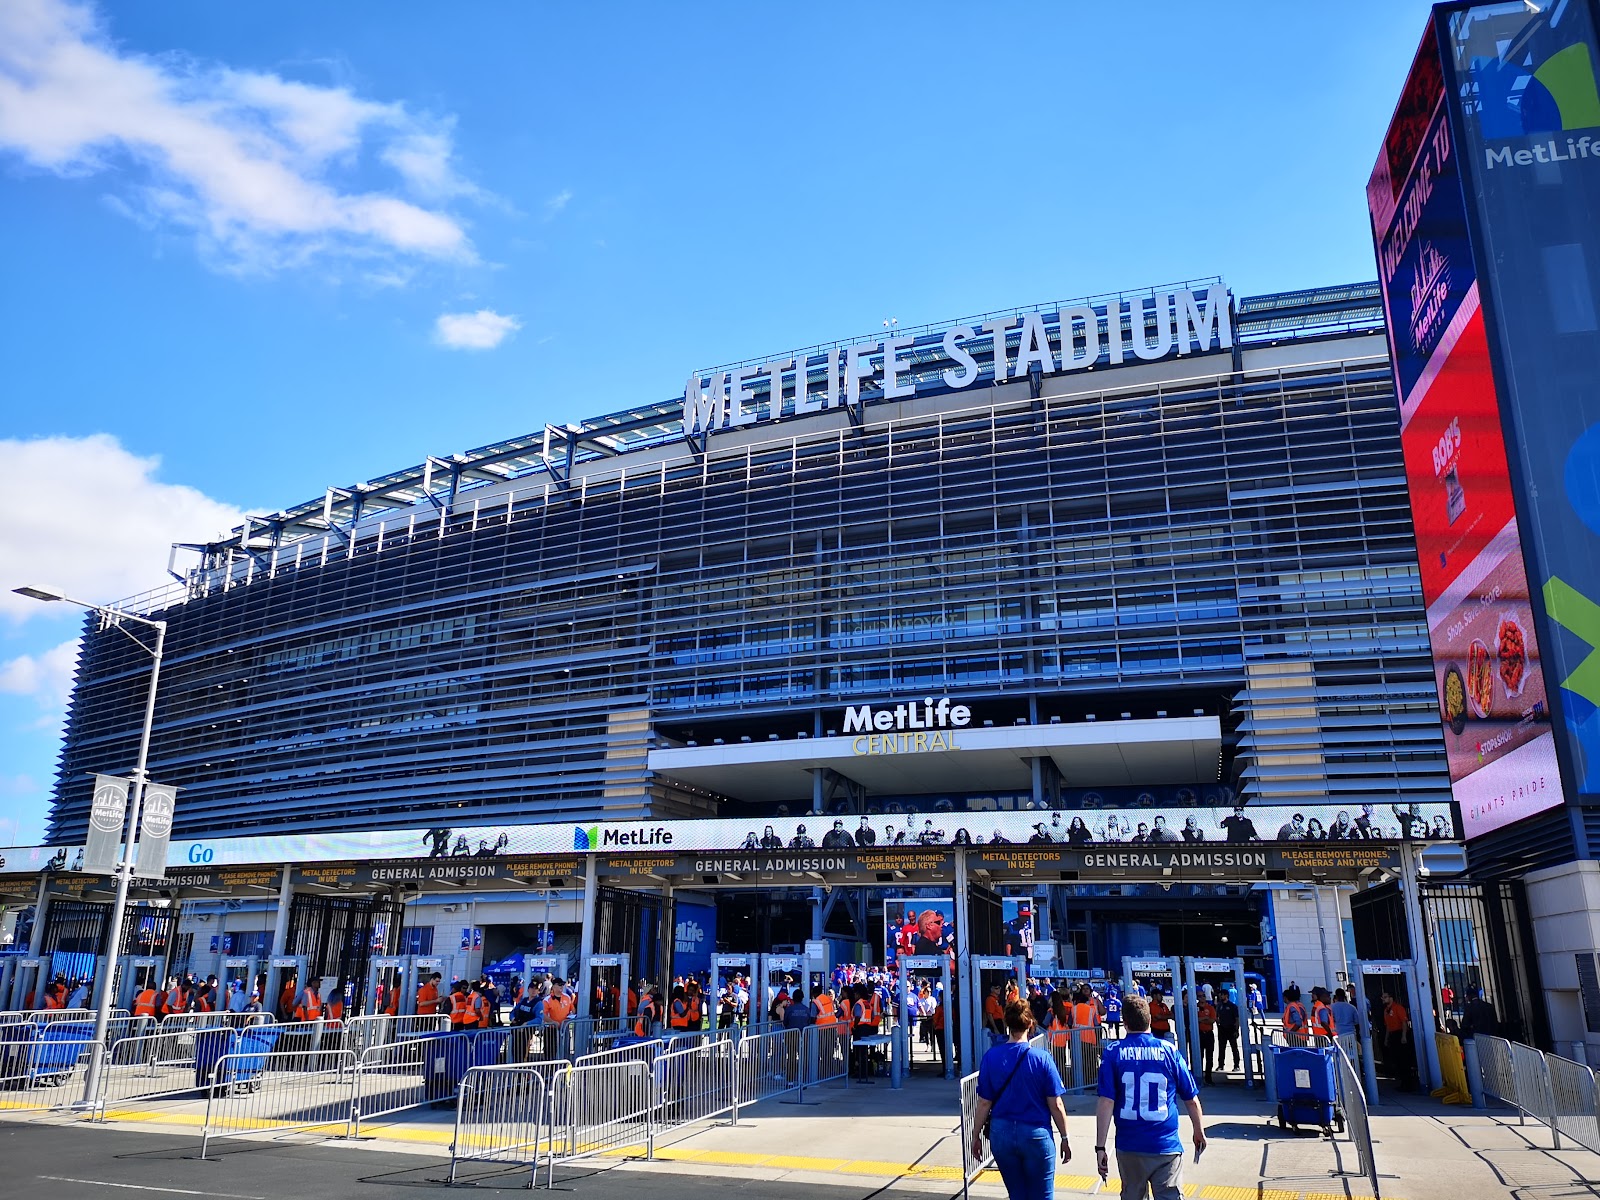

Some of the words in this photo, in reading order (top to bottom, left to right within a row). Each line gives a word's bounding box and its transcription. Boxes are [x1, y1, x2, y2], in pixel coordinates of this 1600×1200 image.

[1385, 152, 1433, 283] WELCOME
[1433, 115, 1449, 174] TO
[1415, 280, 1448, 348] MetLife
[683, 335, 916, 435] METLIFE
[942, 283, 1233, 388] STADIUM
[1432, 416, 1461, 476] BOB'S
[1447, 621, 1464, 643] Shop.
[1480, 585, 1503, 608] Score.
[842, 697, 972, 732] MetLife
[852, 731, 961, 756] CENTRAL
[1470, 795, 1505, 820] GIANTS
[1512, 777, 1545, 802] PRIDE
[95, 809, 123, 818] MetLife
[145, 815, 170, 826] MetLife
[603, 828, 673, 846] MetLife
[188, 844, 214, 864] Go
[857, 855, 884, 863] PLEASE
[885, 854, 913, 862] REMOVE
[915, 854, 947, 863] PHONES,
[982, 853, 1010, 861] METAL
[1011, 852, 1061, 861] DETECTORS
[1084, 853, 1162, 867] GENERAL
[1169, 853, 1266, 867] ADMISSION
[1281, 851, 1314, 859] PLEASE
[1315, 851, 1350, 859] REMOVE
[1352, 851, 1391, 860] PHONES,
[609, 860, 632, 868] METAL
[633, 859, 675, 867] DETECTORS
[695, 858, 761, 872] GENERAL
[765, 857, 846, 872] ADMISSION
[901, 862, 917, 870] AND
[1018, 860, 1036, 868] USE
[1294, 859, 1331, 867] CAMERAS
[1333, 859, 1354, 867] AND
[1355, 859, 1380, 867] KEYS
[218, 872, 237, 880] PLEASE
[322, 868, 356, 876] DETECTORS
[371, 867, 425, 879] GENERAL
[429, 865, 496, 879] ADMISSION
[638, 867, 653, 875] USE
[111, 878, 153, 888] GERAL
[156, 874, 210, 887] ADMISSION
[1108, 1004, 1118, 1012] 23
[1120, 1071, 1168, 1122] 10
